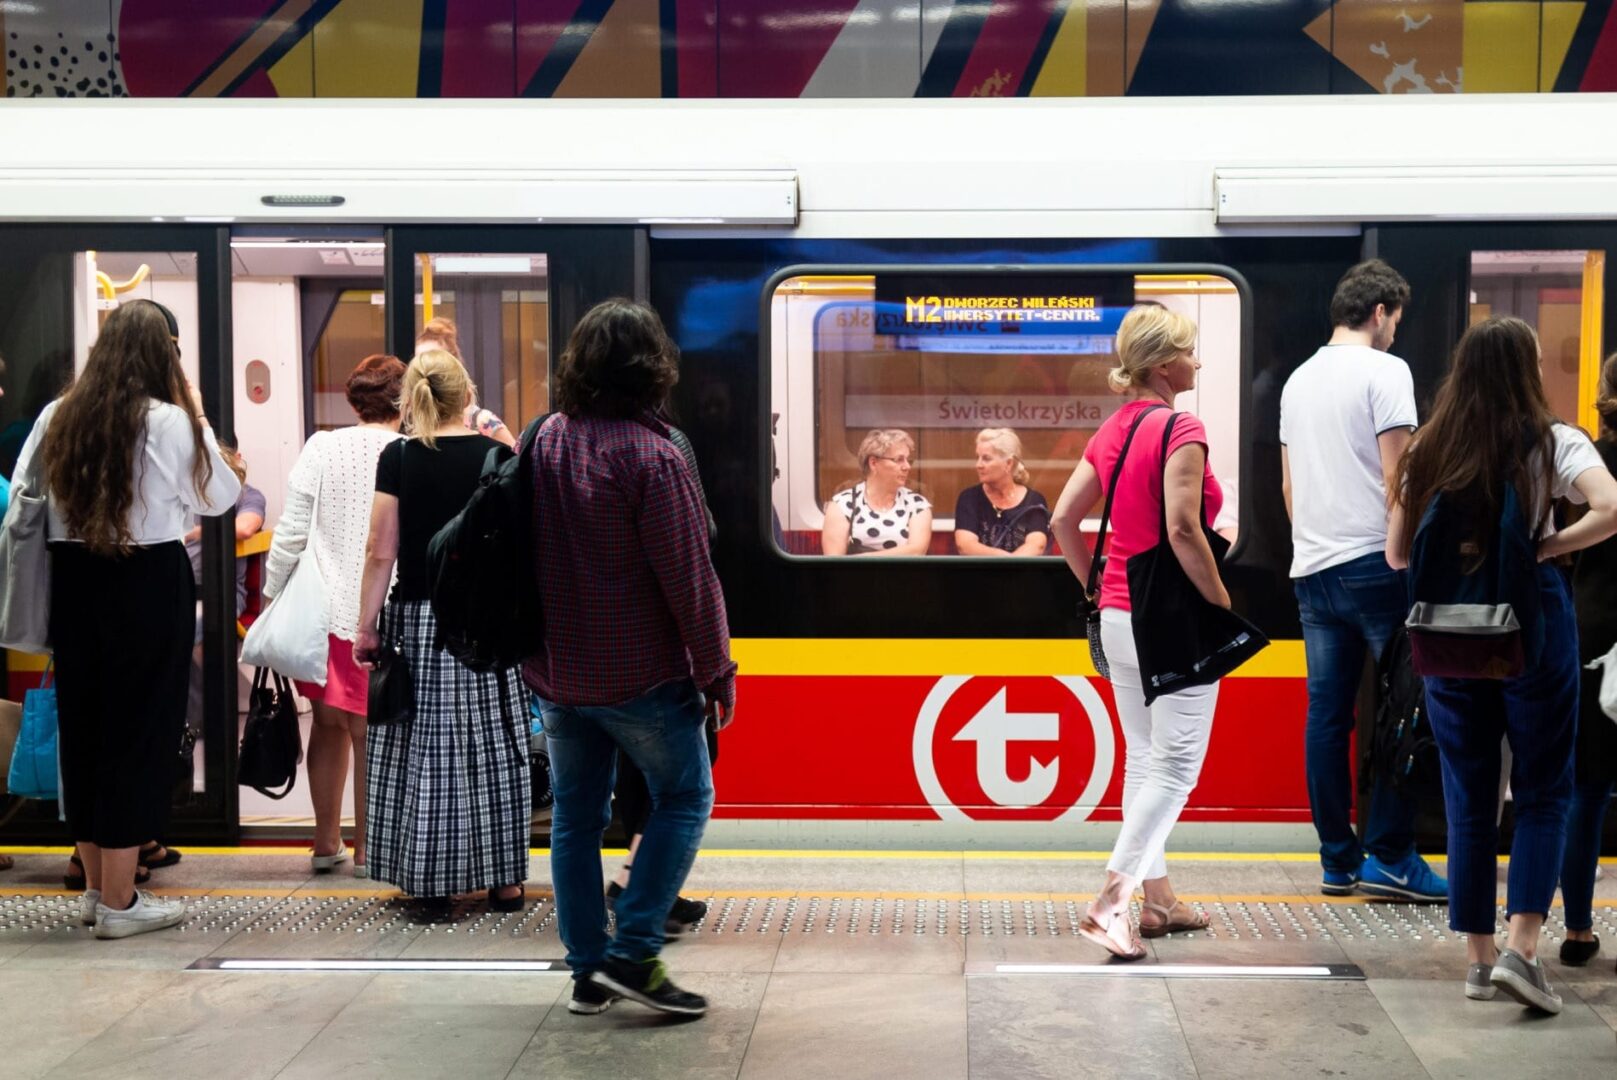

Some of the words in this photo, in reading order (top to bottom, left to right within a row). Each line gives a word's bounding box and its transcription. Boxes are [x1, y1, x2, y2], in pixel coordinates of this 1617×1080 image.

[906, 296, 942, 322] M2
[944, 297, 1018, 308] DWORZEC
[1022, 296, 1095, 308] WILEŃSKI
